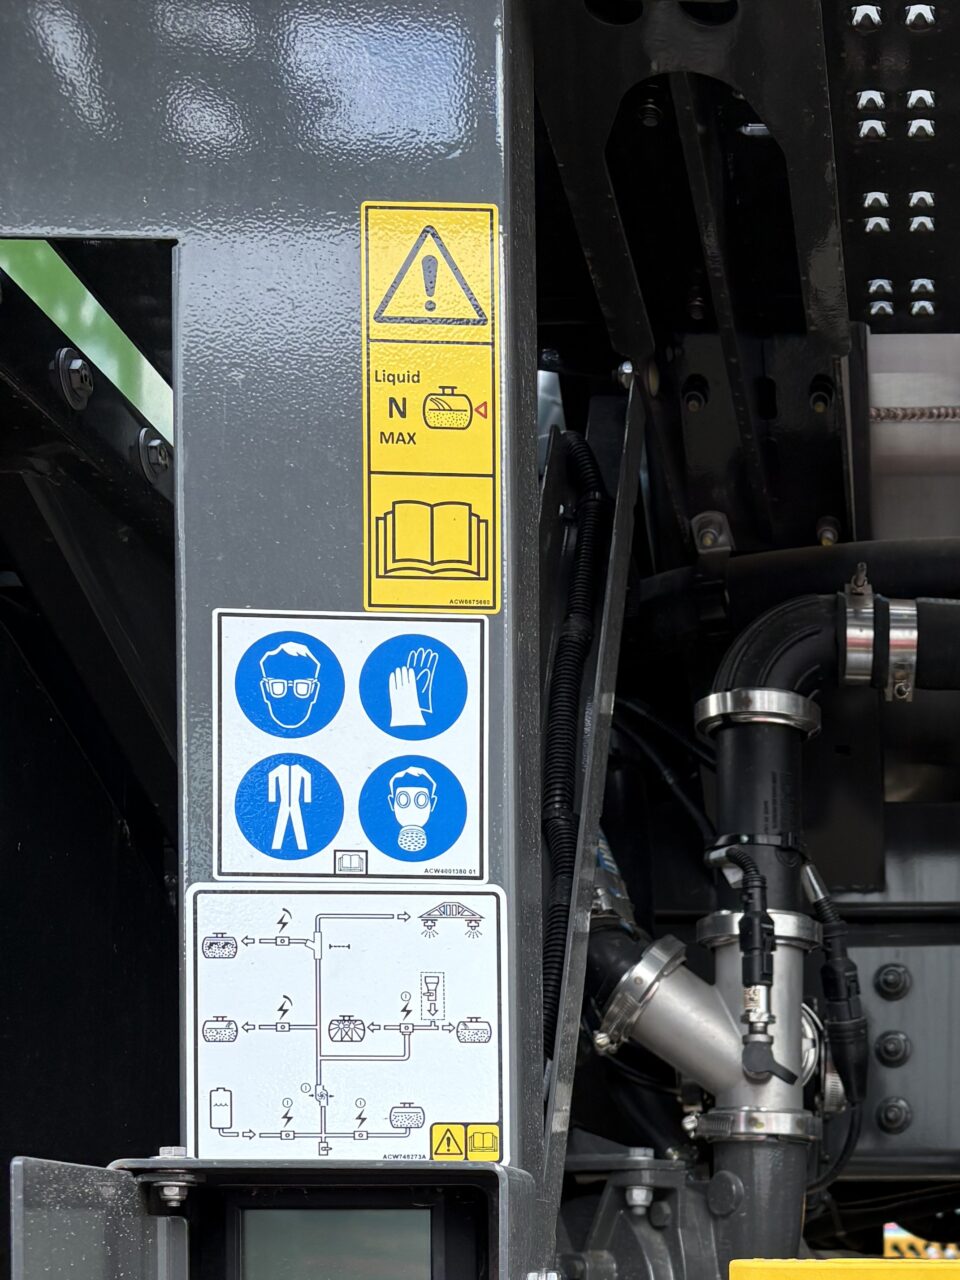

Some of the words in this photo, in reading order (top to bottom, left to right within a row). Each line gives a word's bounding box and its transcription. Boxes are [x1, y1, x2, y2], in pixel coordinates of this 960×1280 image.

[375, 370, 421, 386] Liquid
[388, 397, 407, 418] N
[380, 431, 416, 445] MAX
